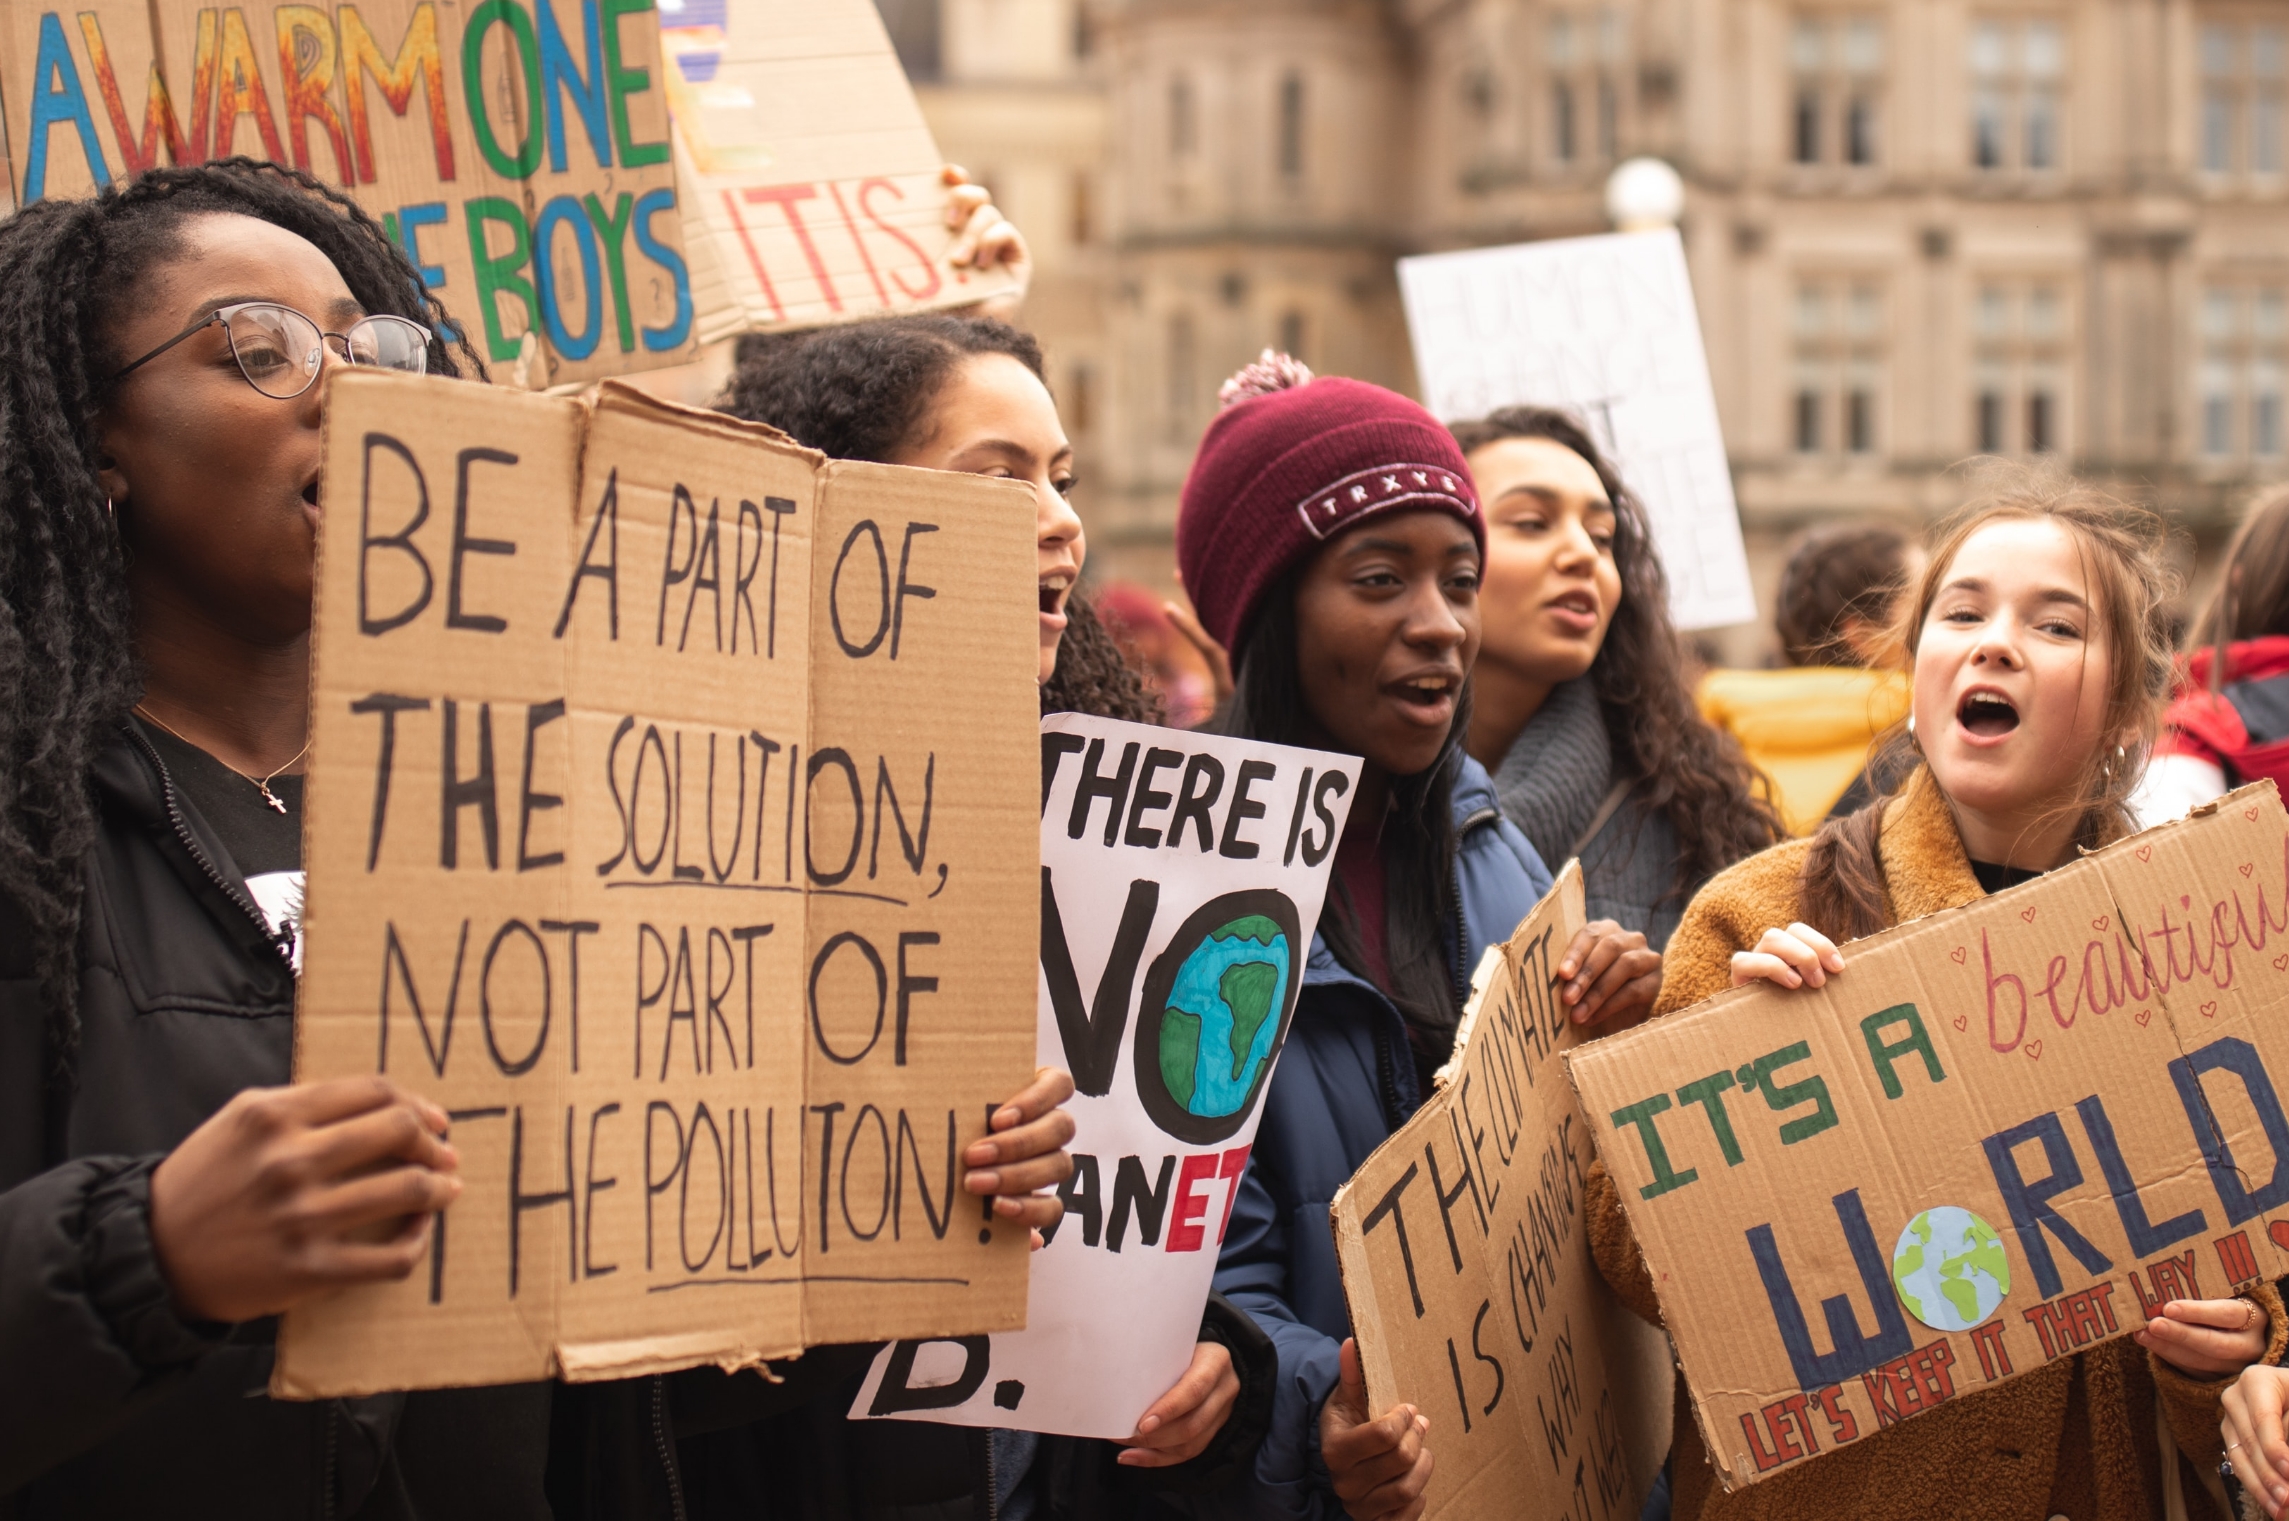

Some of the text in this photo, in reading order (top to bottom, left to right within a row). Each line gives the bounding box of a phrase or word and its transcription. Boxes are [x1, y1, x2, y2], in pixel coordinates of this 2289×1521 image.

[22, 11, 113, 206] A
[77, 1, 456, 188] WARM
[461, 0, 671, 181] ONE
[463, 188, 694, 363] BOYS
[722, 182, 843, 323] IT
[358, 432, 940, 661] BE A PART OF
[350, 692, 949, 899] THE SOLUTION,
[1041, 731, 1350, 868] THERE IS
[377, 917, 942, 1082] NOT PART OF
[1361, 923, 1566, 1319] THE CLIMATE
[1610, 1039, 1840, 1200] IT'S
[1859, 1002, 1948, 1100] A
[428, 1102, 621, 1304] THE
[1042, 1143, 1253, 1254] ANET
[1446, 1298, 1505, 1434] IS
[1537, 1313, 1582, 1477] WHY
[1739, 1382, 1860, 1474] LET'S
[1860, 1337, 1957, 1430] KEEP
[1969, 1318, 2015, 1383] IT
[2021, 1279, 2120, 1362] THAT
[2128, 1248, 2203, 1322] WAY
